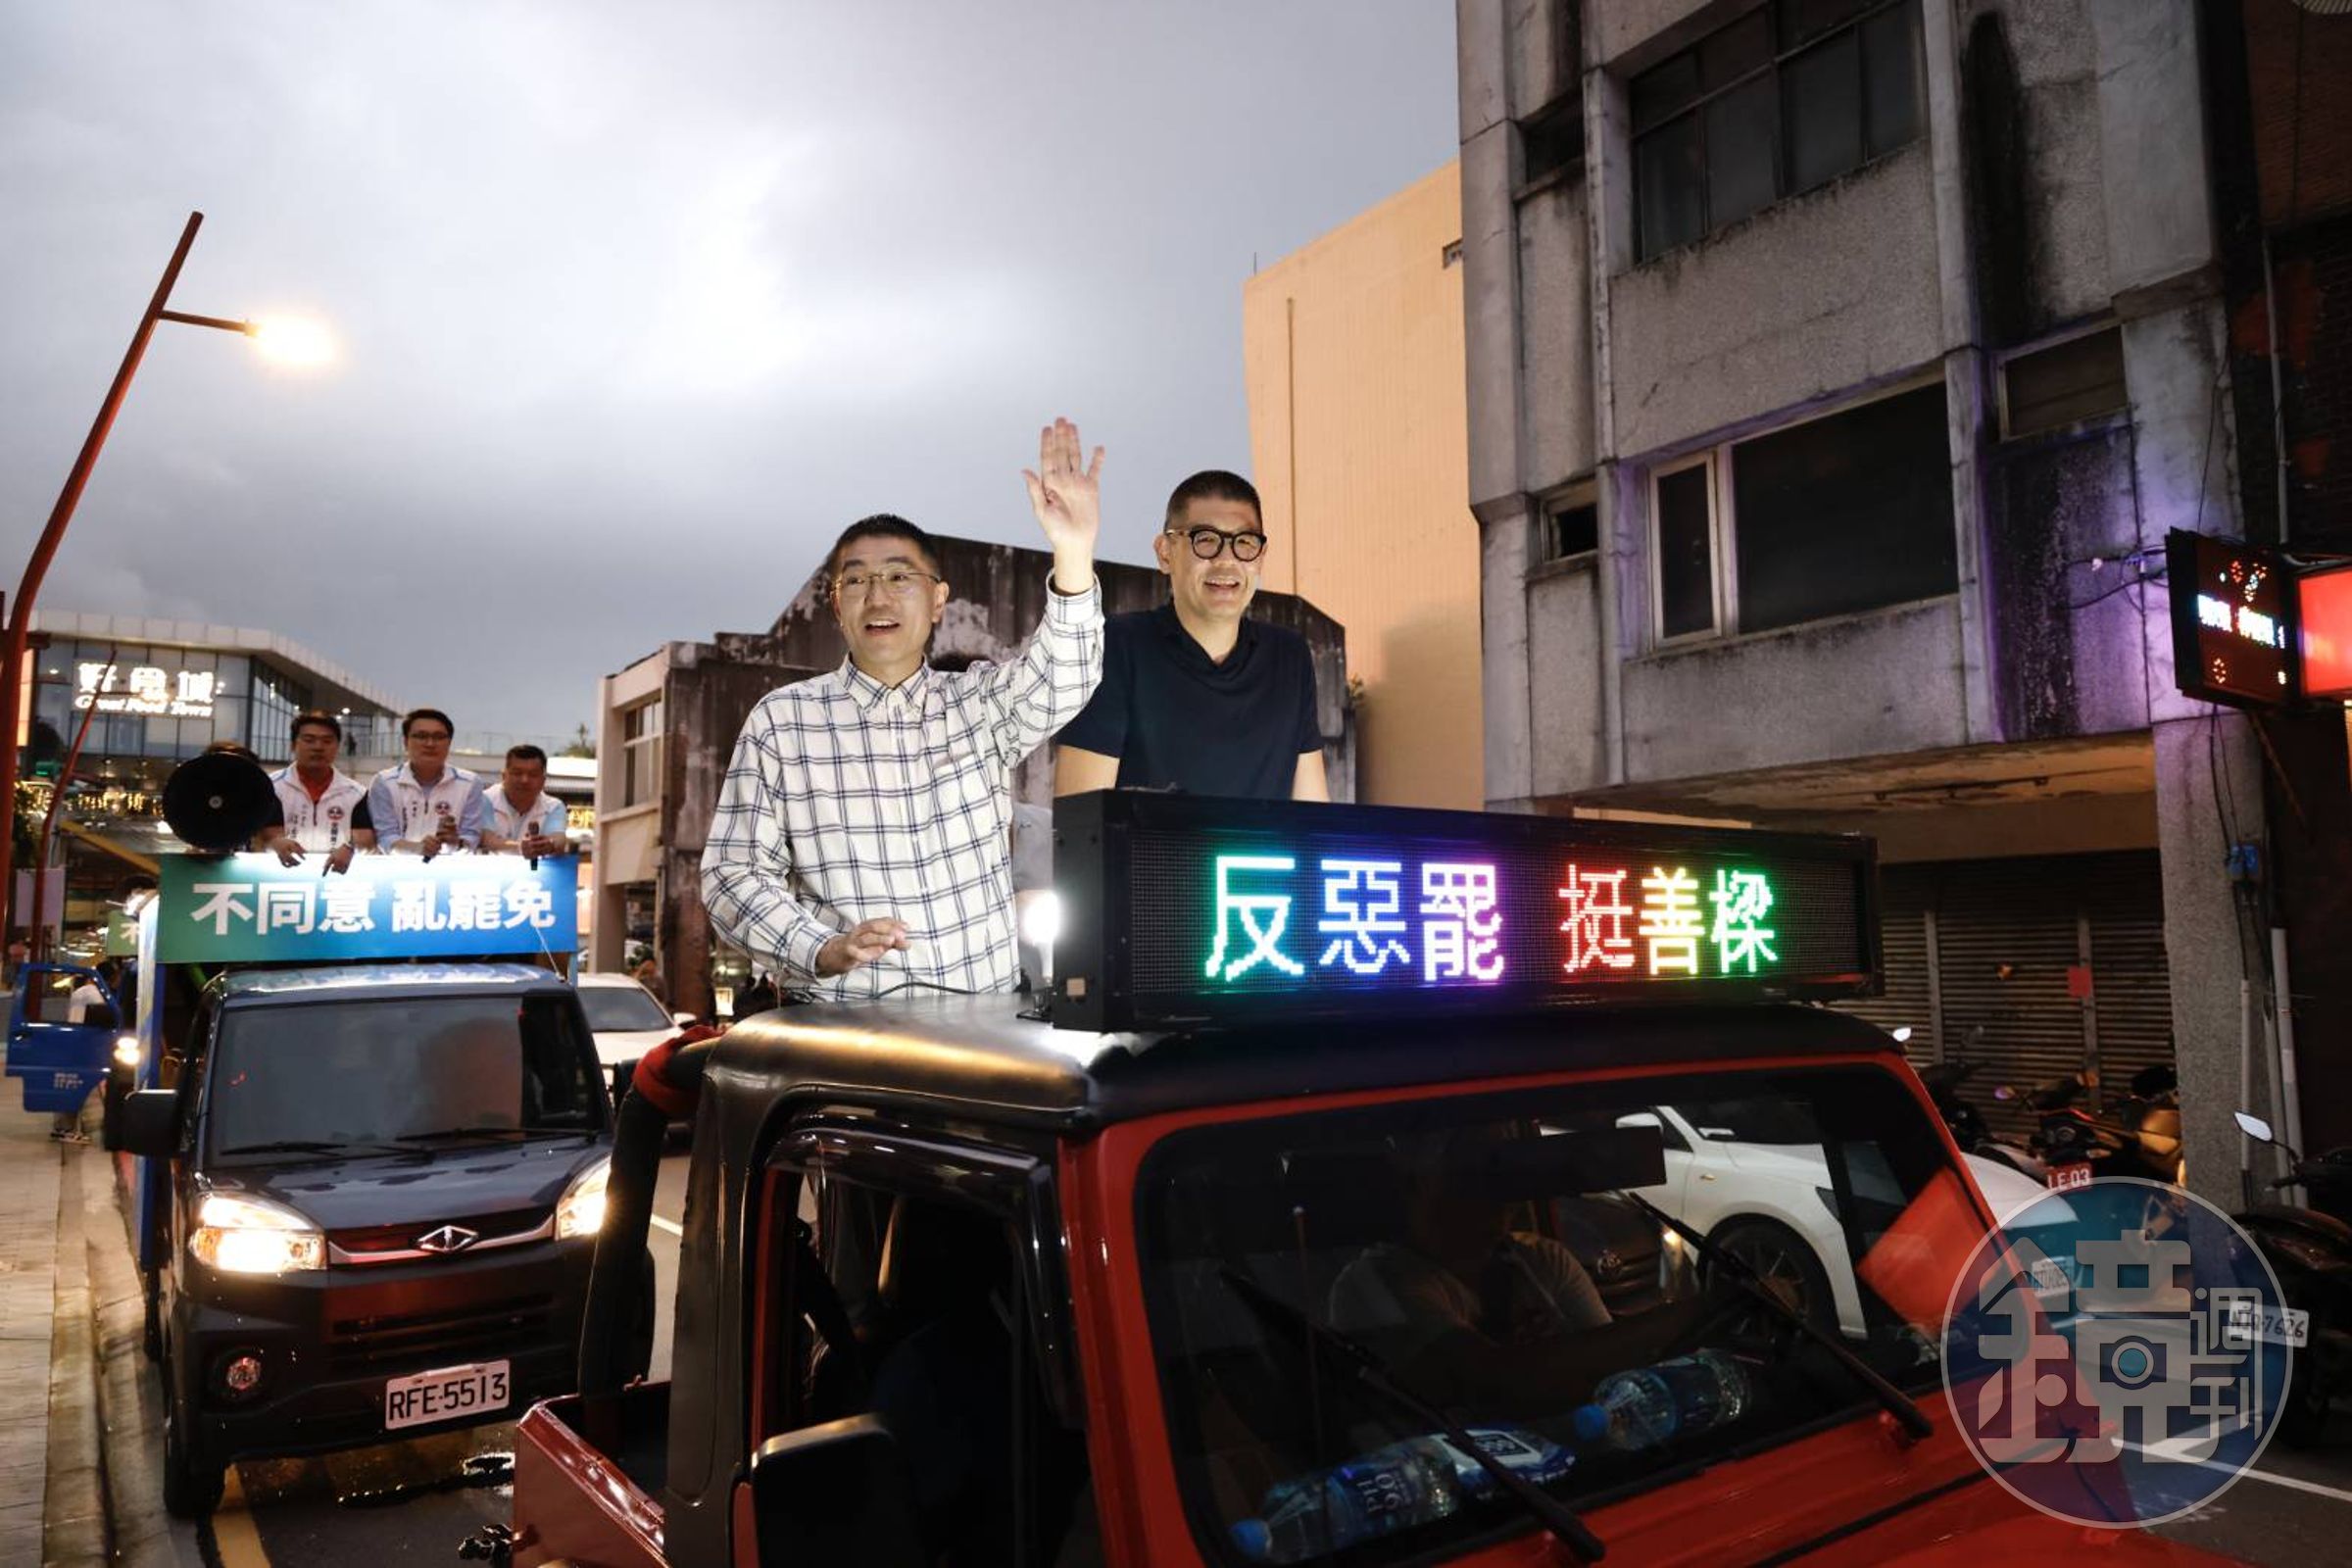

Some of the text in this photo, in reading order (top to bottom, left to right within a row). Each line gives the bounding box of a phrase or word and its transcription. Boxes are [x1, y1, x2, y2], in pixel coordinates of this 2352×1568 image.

[191, 879, 557, 936] 不同意 亂罷免
[1205, 855, 1778, 982] 反惡罷 挺善樑
